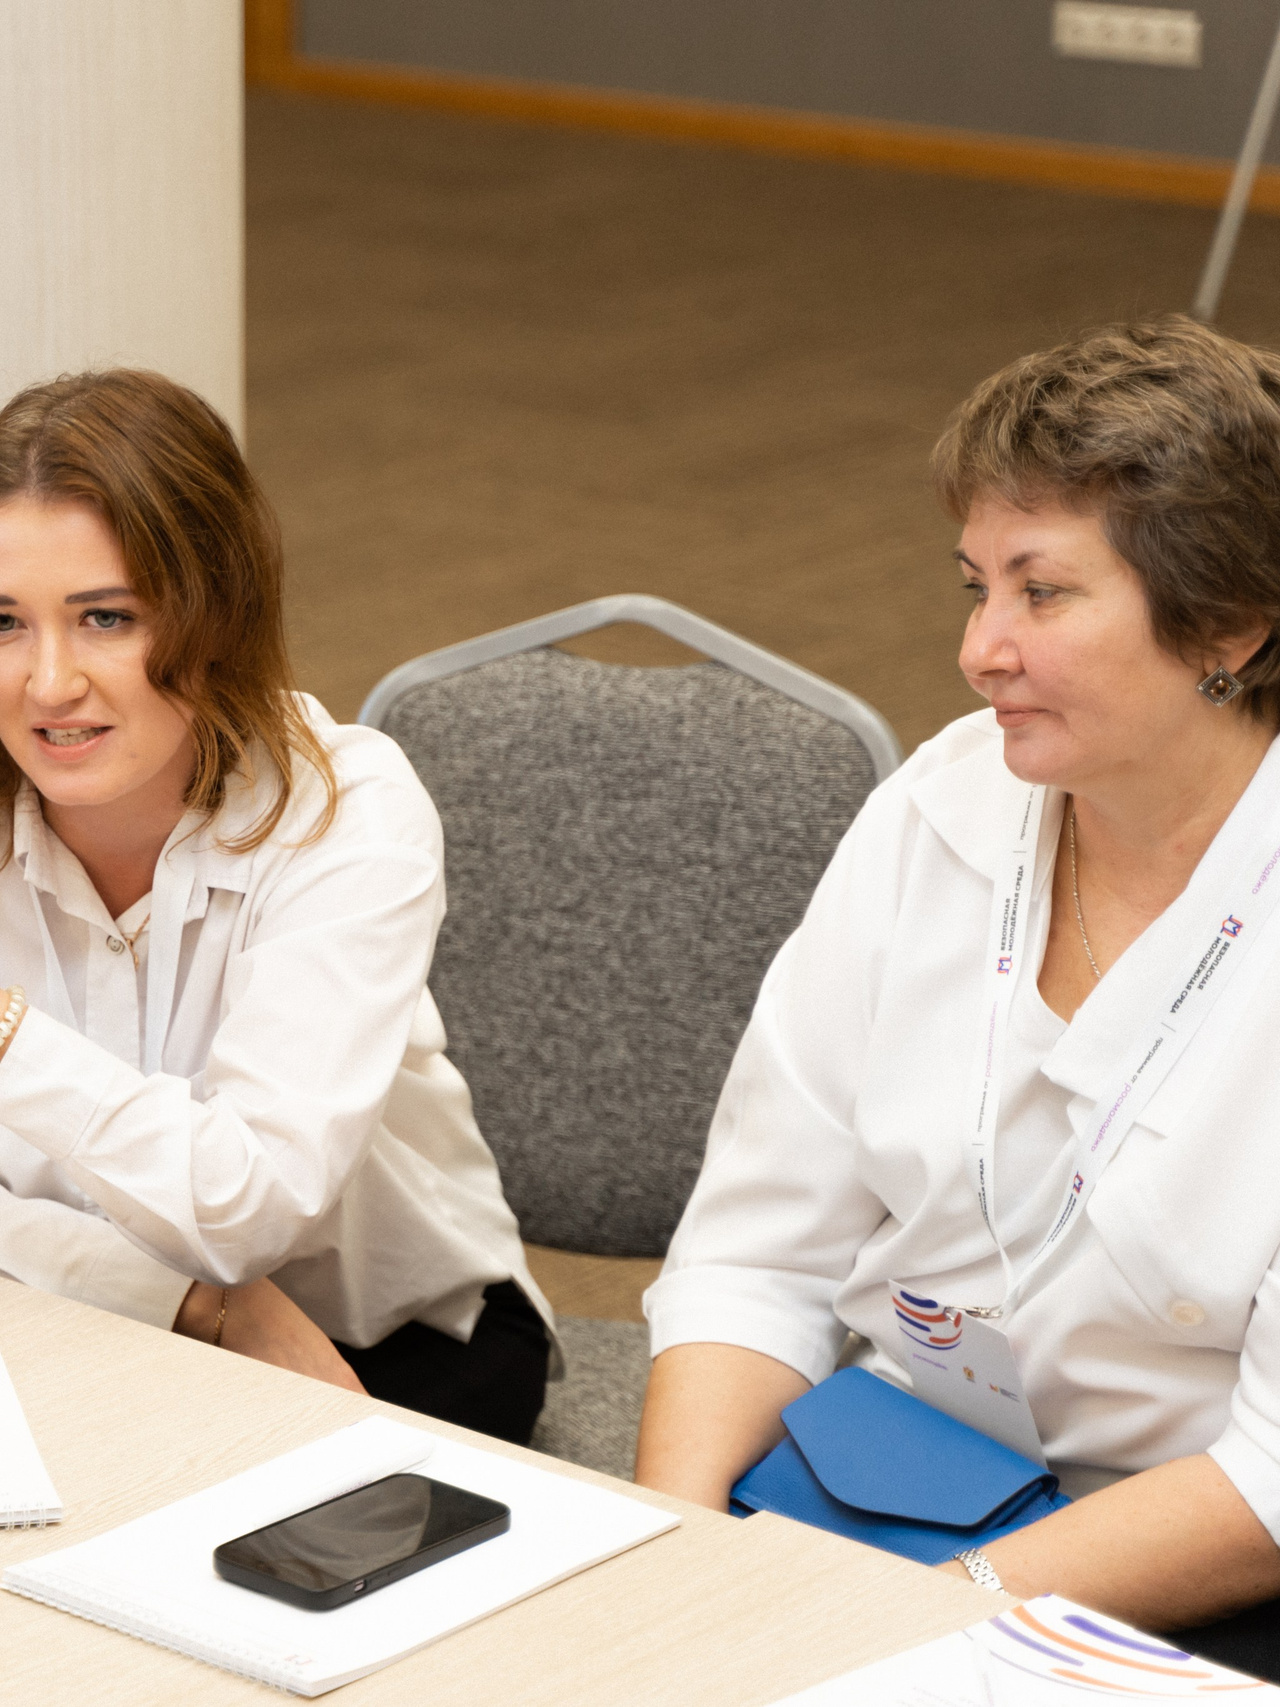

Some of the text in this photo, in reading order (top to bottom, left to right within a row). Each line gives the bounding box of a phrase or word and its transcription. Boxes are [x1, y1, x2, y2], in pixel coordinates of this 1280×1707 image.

[1252, 845, 1280, 895] олодёжь
[1001, 897, 1011, 951] БЕЗОПАСНАЯ
[1008, 864, 1024, 951] МОЛОДЁЖНАЯ СРЕДА
[1169, 936, 1222, 1014] МОЛОДЁЖНАЯ СРЕДА
[1196, 941, 1231, 991] БЕЗОПАСНАЯ
[1136, 1036, 1164, 1074] программа
